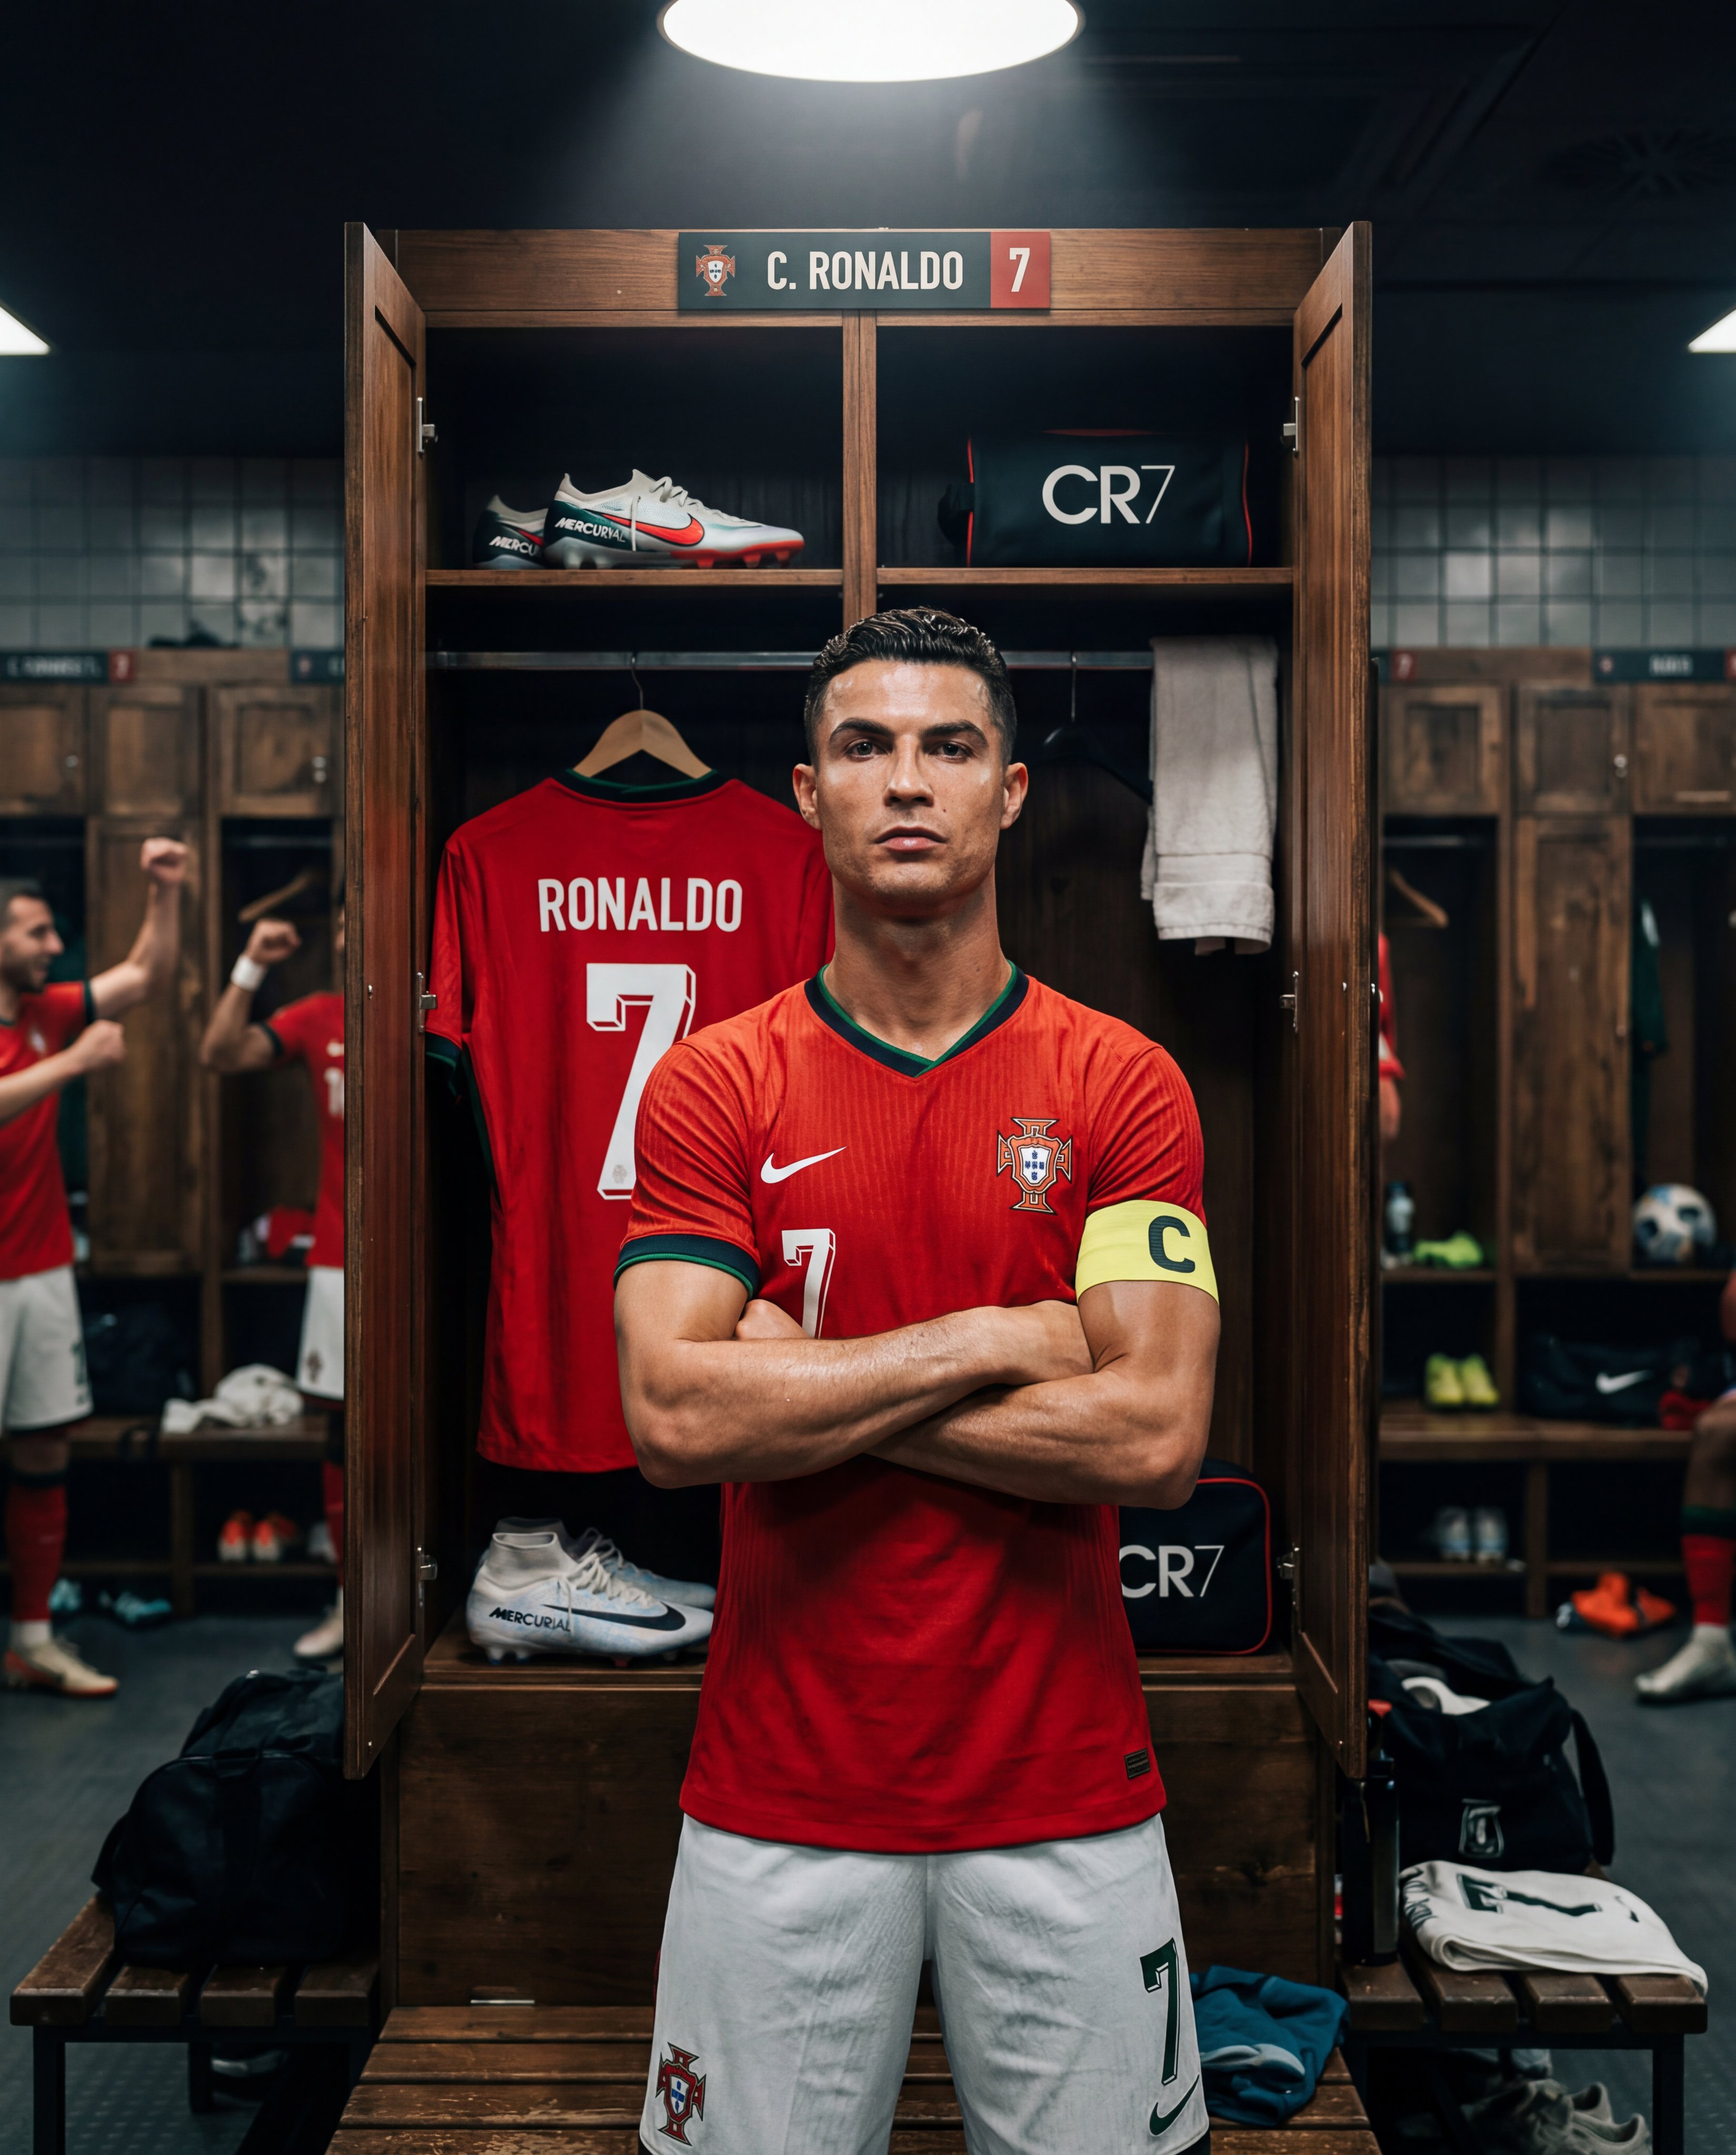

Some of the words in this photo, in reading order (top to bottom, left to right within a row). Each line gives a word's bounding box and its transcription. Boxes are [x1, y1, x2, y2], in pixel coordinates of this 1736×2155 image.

[768, 250, 796, 290] C.
[809, 250, 963, 290] RONALDO
[1008, 247, 1031, 292] 7
[1042, 464, 1175, 525] CR7
[538, 877, 743, 932] RONALDO
[586, 963, 697, 1200] 7
[1148, 1215, 1196, 1273] C
[782, 1228, 836, 1339] 7
[1119, 1544, 1225, 1598] CR7
[489, 1606, 571, 1632] MERCURIAL
[1139, 1937, 1180, 2087] 7
